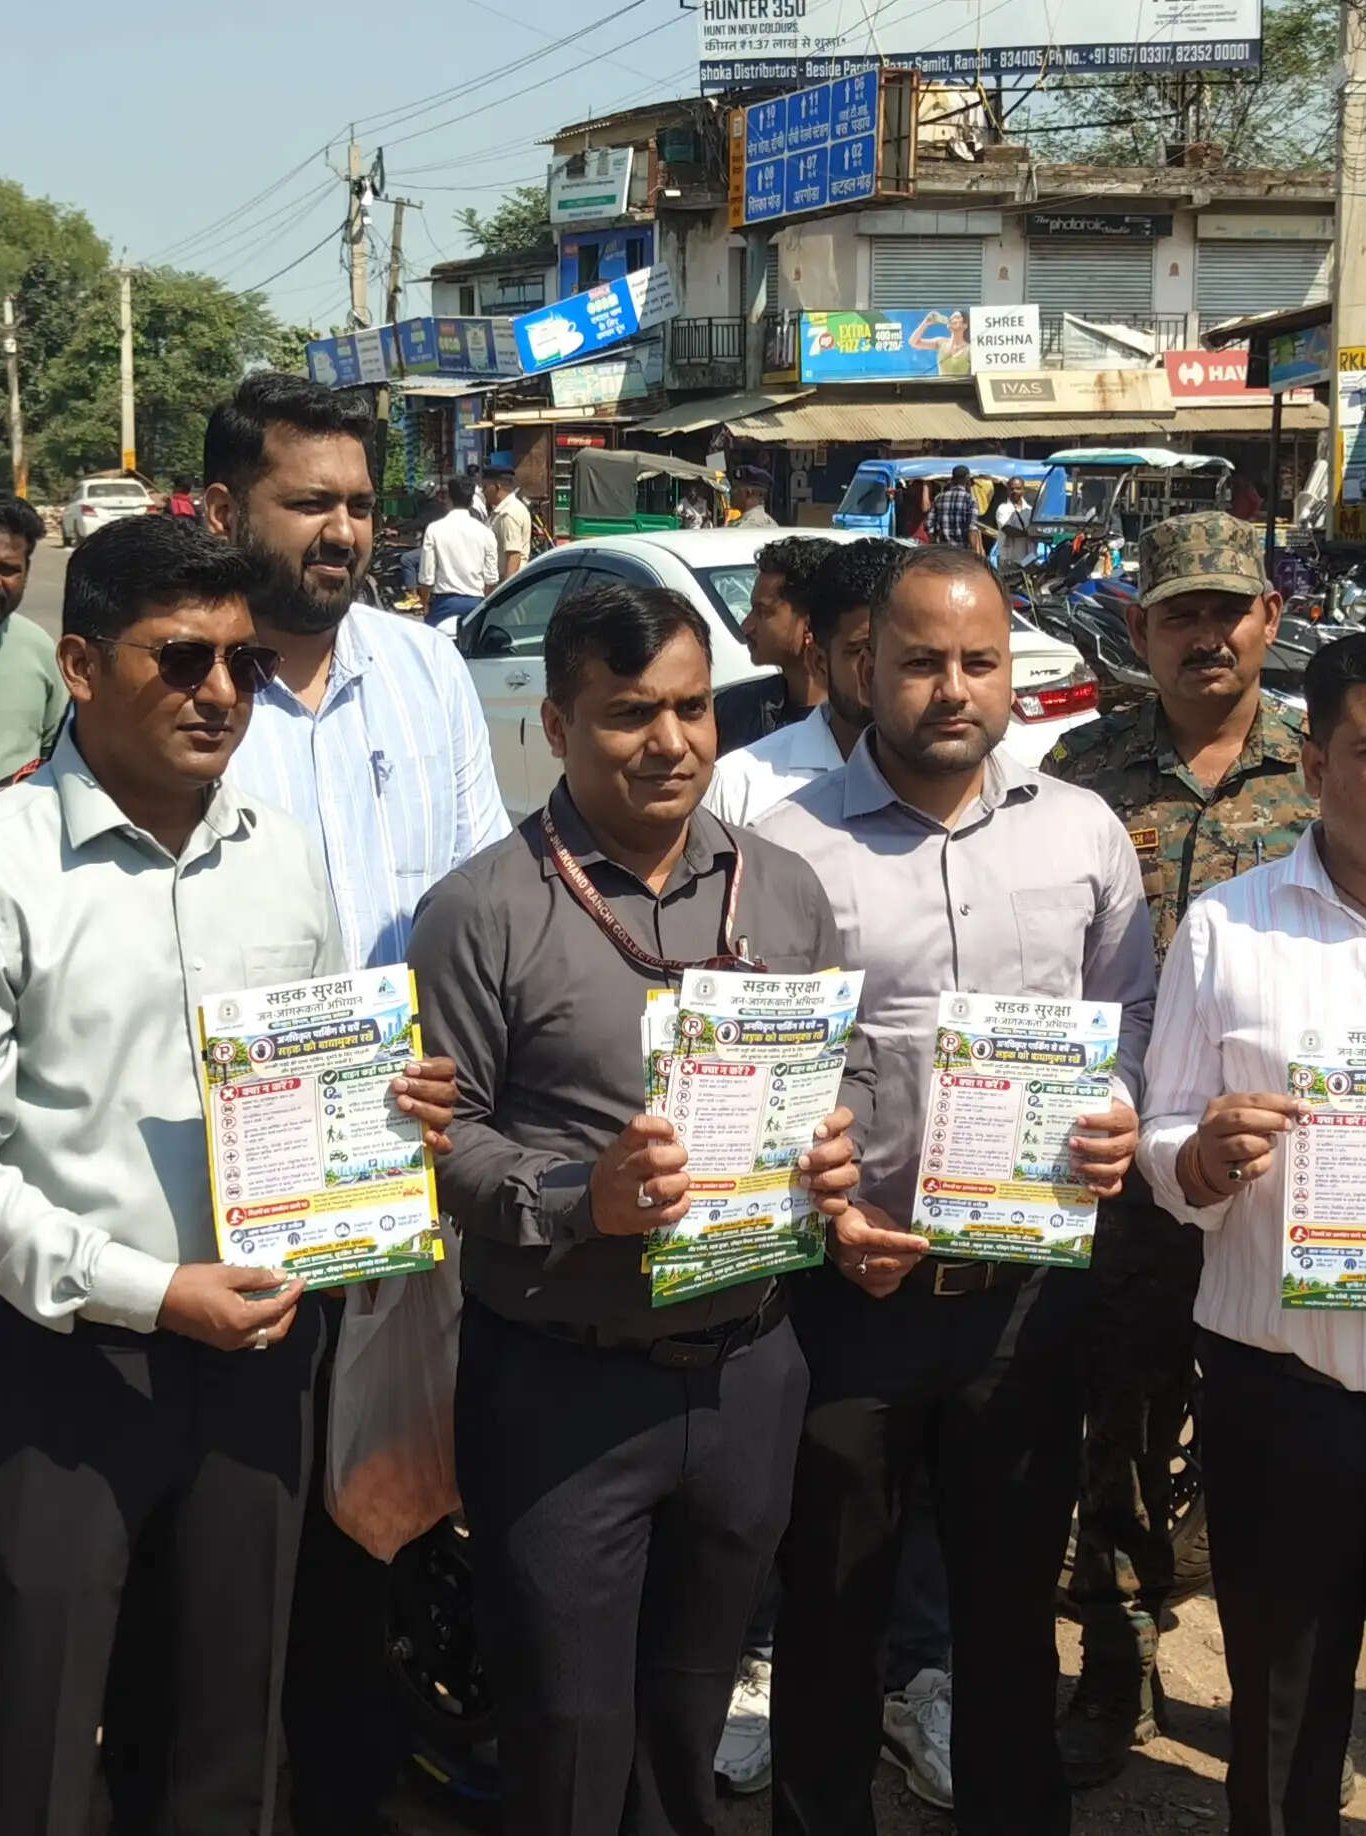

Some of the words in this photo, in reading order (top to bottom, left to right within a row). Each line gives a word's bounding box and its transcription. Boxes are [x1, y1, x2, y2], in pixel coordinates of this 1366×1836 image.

[704, 0, 768, 20] HUNTER
[773, 0, 805, 17] 350
[704, 24, 726, 36] HUNT
[728, 24, 737, 35] IN
[738, 23, 757, 35] NEW
[705, 38, 736, 51] कीमत
[772, 38, 798, 49] लाख
[801, 36, 811, 48] से
[734, 62, 797, 79] Distributors
[806, 59, 841, 78] Beside
[915, 55, 952, 73] Samiti,
[954, 53, 991, 69] Ranchi
[1049, 49, 1063, 65] Ph
[1088, 48, 1106, 63] +91
[1176, 45, 1213, 61] 82352
[1214, 43, 1249, 60] 00001
[809, 92, 819, 103] 11
[766, 105, 776, 119] 10
[851, 143, 863, 158] 02
[985, 316, 1025, 328] SHREE
[839, 324, 871, 338] EXTRA
[837, 338, 859, 354] FIZZ
[977, 334, 1033, 347] KRISHNA
[985, 354, 1026, 365] STORE
[1002, 382, 1043, 395] IVAS
[549, 832, 588, 891] JHARKHAND
[584, 883, 616, 928] RANCHI
[266, 988, 307, 1007] सड़क
[312, 979, 353, 1002] सुरक्षा
[742, 980, 780, 997] सड़क
[785, 980, 822, 998] सुरक्षा
[257, 1003, 325, 1021] जन-जागरूकता
[328, 995, 363, 1010] अभियान
[1034, 1002, 1072, 1020] सुरक्षा
[339, 1022, 347, 1034] से
[765, 1031, 777, 1041] को
[277, 1043, 302, 1058] सड़क
[304, 1041, 316, 1052] को
[240, 1085, 262, 1097] क्या
[262, 1084, 271, 1094] न
